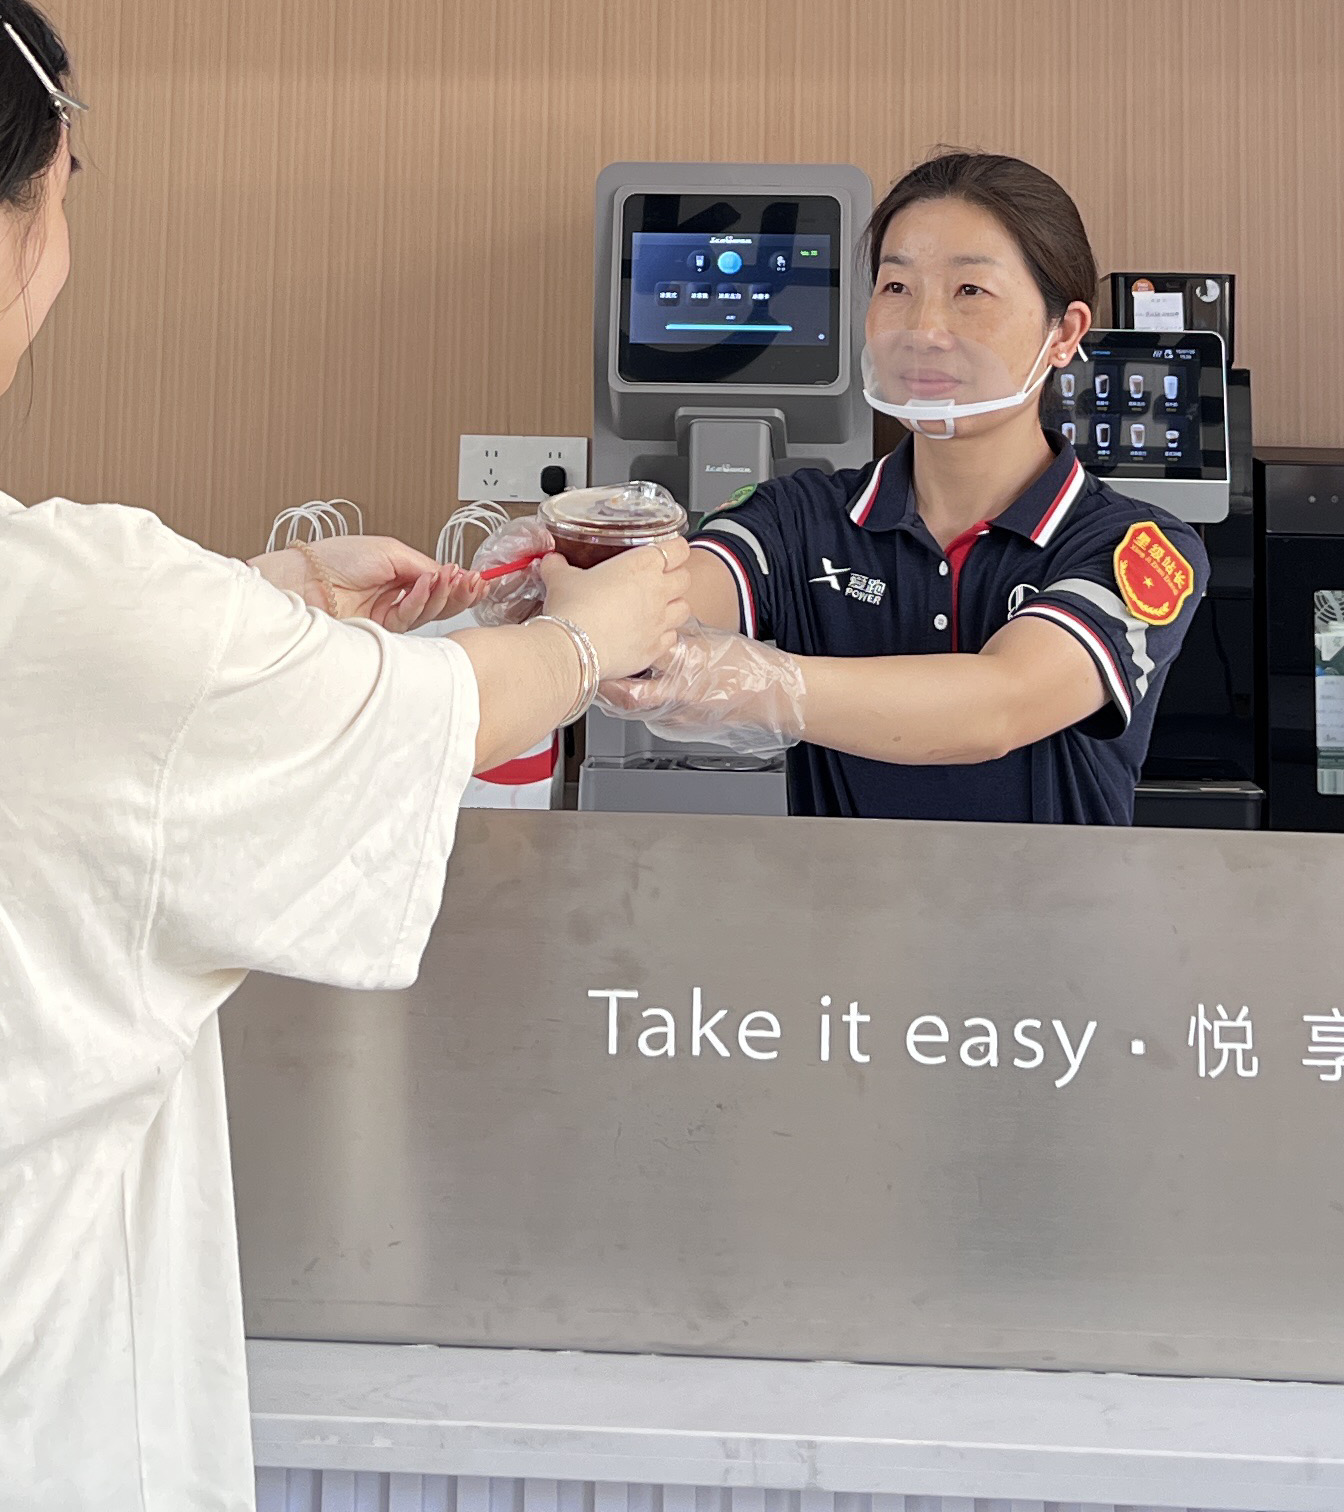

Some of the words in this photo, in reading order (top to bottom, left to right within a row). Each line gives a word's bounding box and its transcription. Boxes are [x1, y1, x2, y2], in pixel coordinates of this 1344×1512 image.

[1133, 531, 1186, 590] 星级站长
[845, 587, 882, 605] POWER
[588, 987, 782, 1060] Take
[819, 994, 872, 1064] it
[906, 1007, 1099, 1088] easy
